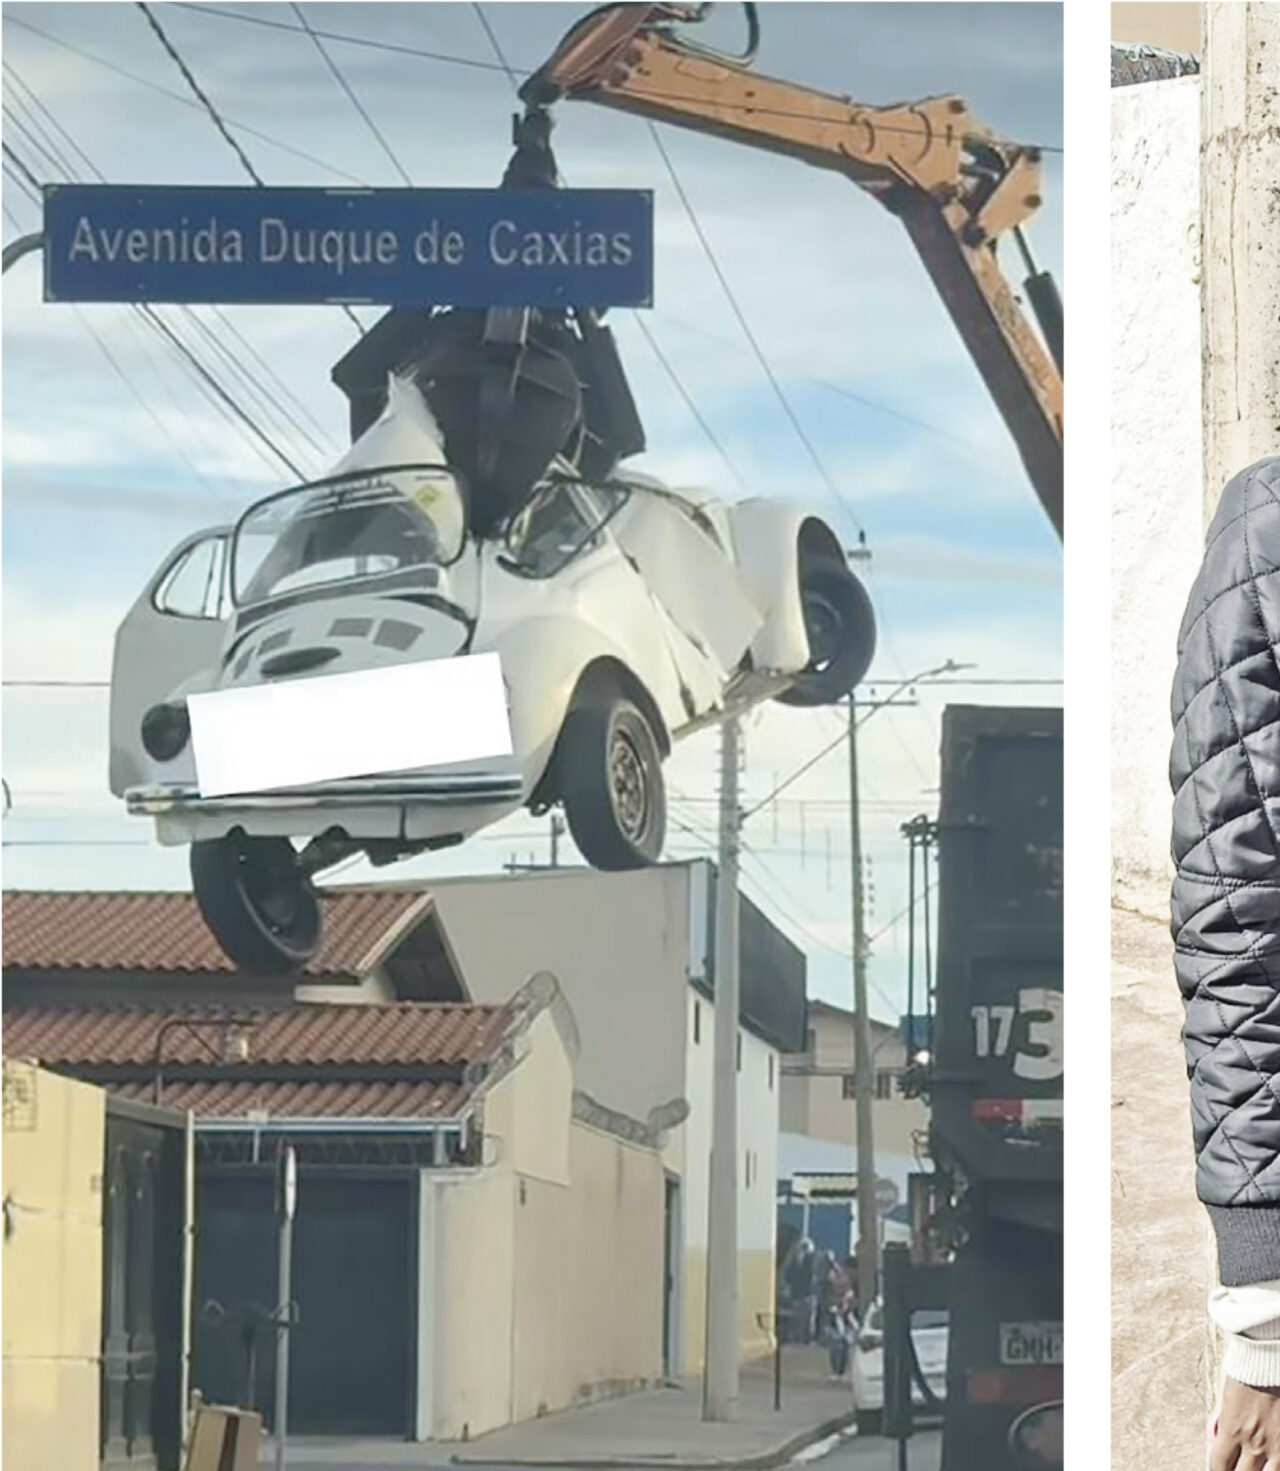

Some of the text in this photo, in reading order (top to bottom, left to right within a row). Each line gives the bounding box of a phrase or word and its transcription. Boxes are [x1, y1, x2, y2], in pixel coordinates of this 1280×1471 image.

[68, 216, 632, 275] Avenida Duque de Caxias
